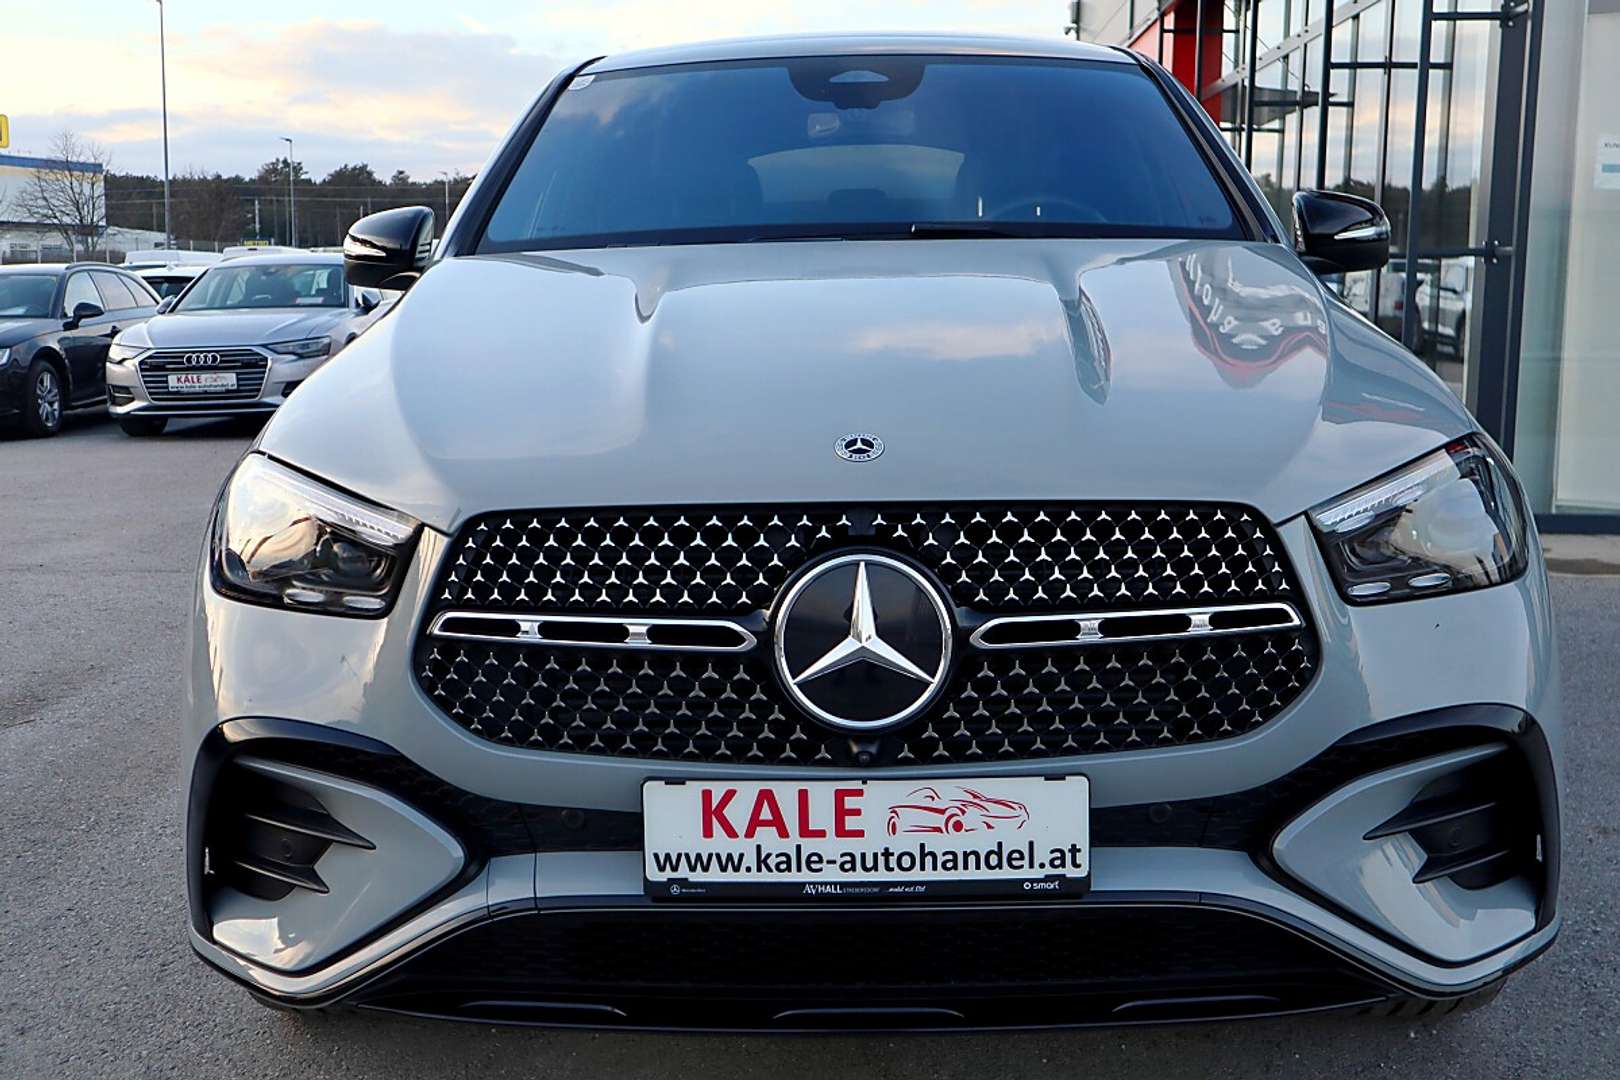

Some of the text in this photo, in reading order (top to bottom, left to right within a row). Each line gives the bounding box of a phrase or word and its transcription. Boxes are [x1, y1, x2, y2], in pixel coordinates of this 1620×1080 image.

[176, 375, 202, 384] KALE
[702, 788, 864, 839] KALE
[652, 840, 1082, 873] www.kale-autohandel.at
[1032, 881, 1060, 890] smart
